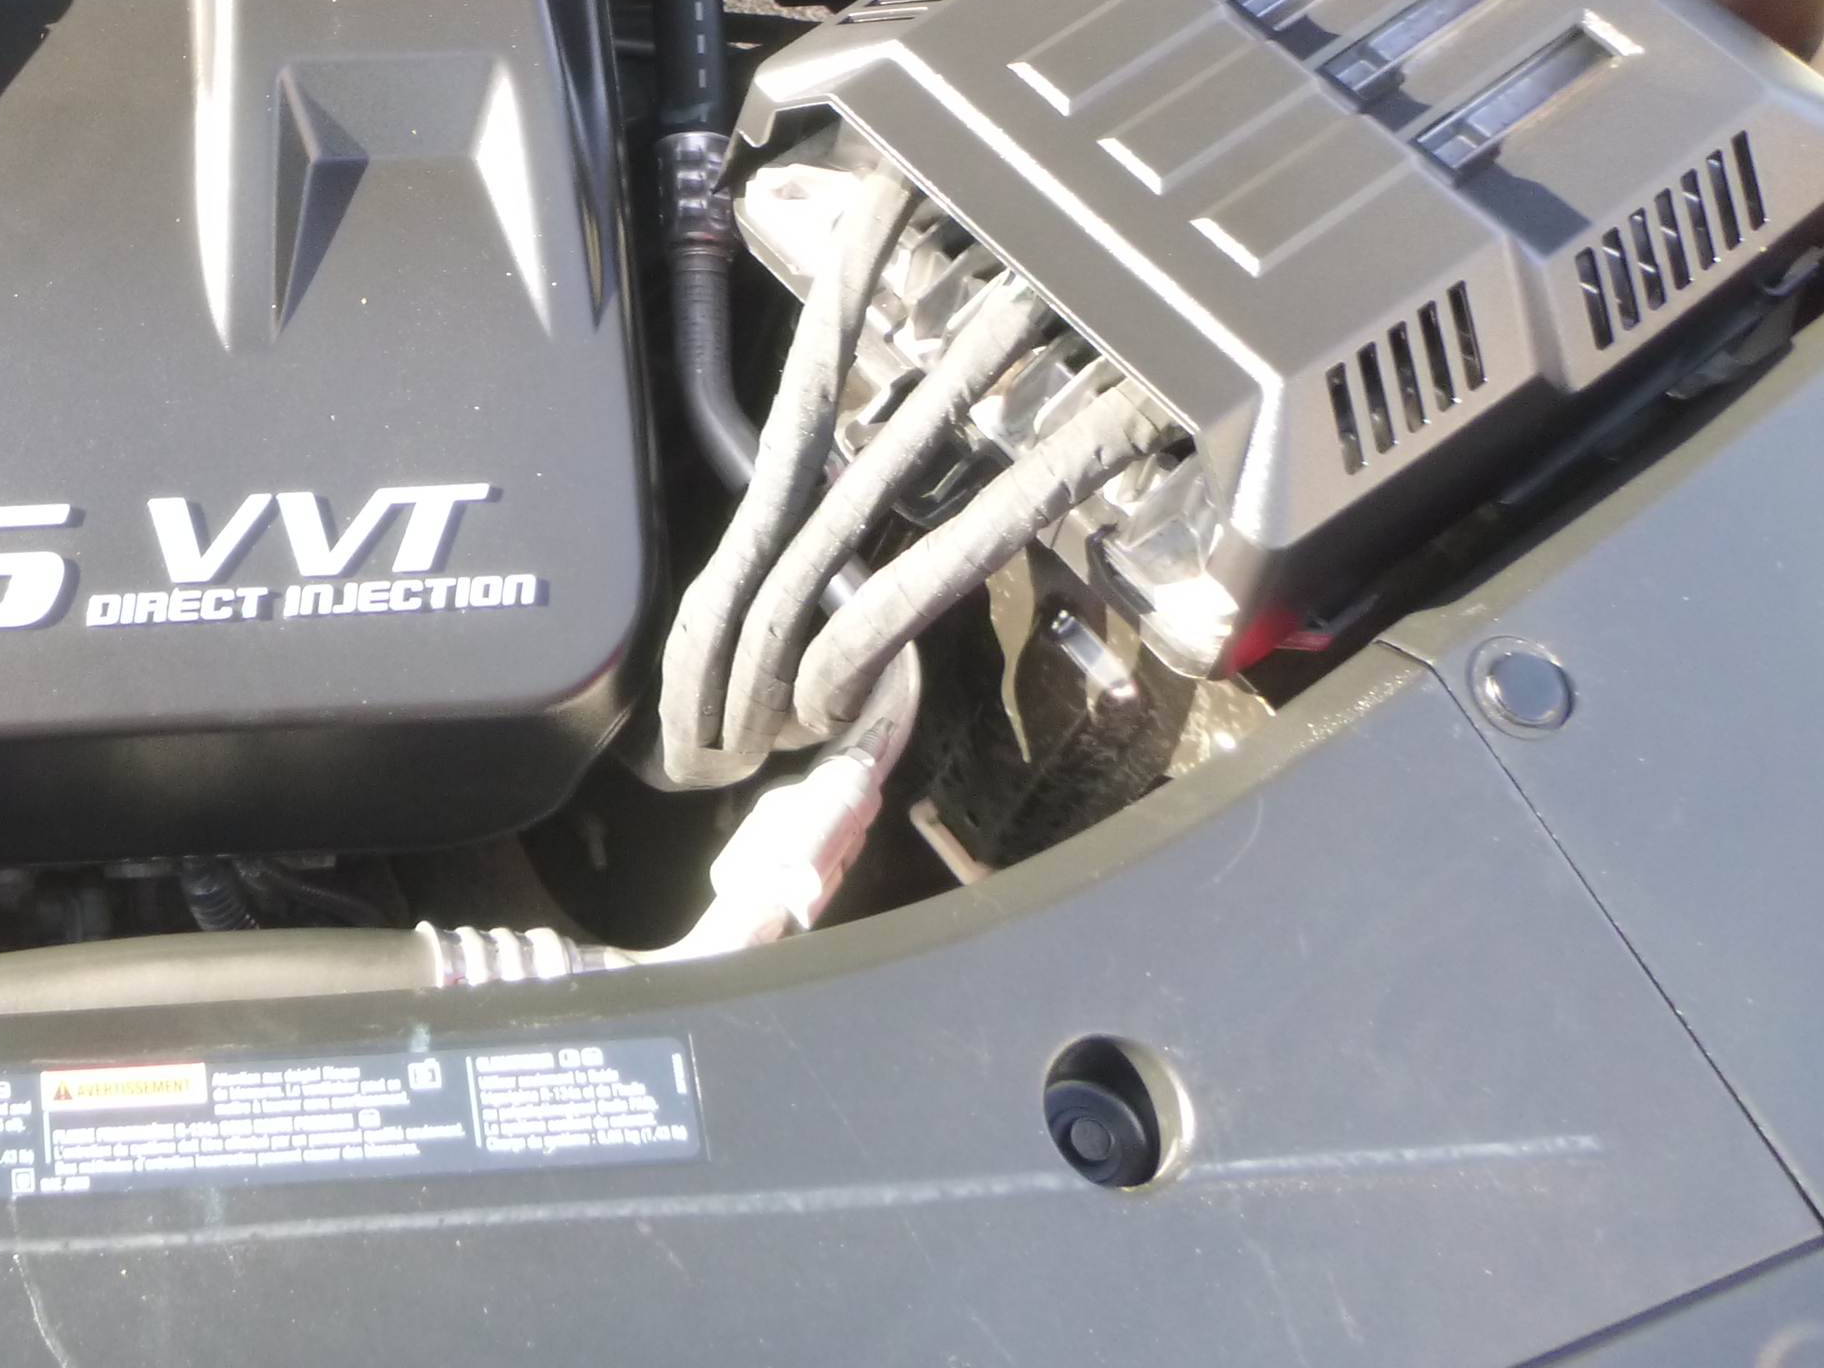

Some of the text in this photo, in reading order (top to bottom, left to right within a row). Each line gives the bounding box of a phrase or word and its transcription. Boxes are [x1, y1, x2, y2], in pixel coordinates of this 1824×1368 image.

[147, 483, 491, 584] VVT
[86, 574, 536, 627] DIRECT INJECTION
[77, 1079, 191, 1098] AVERTISSEMENT
